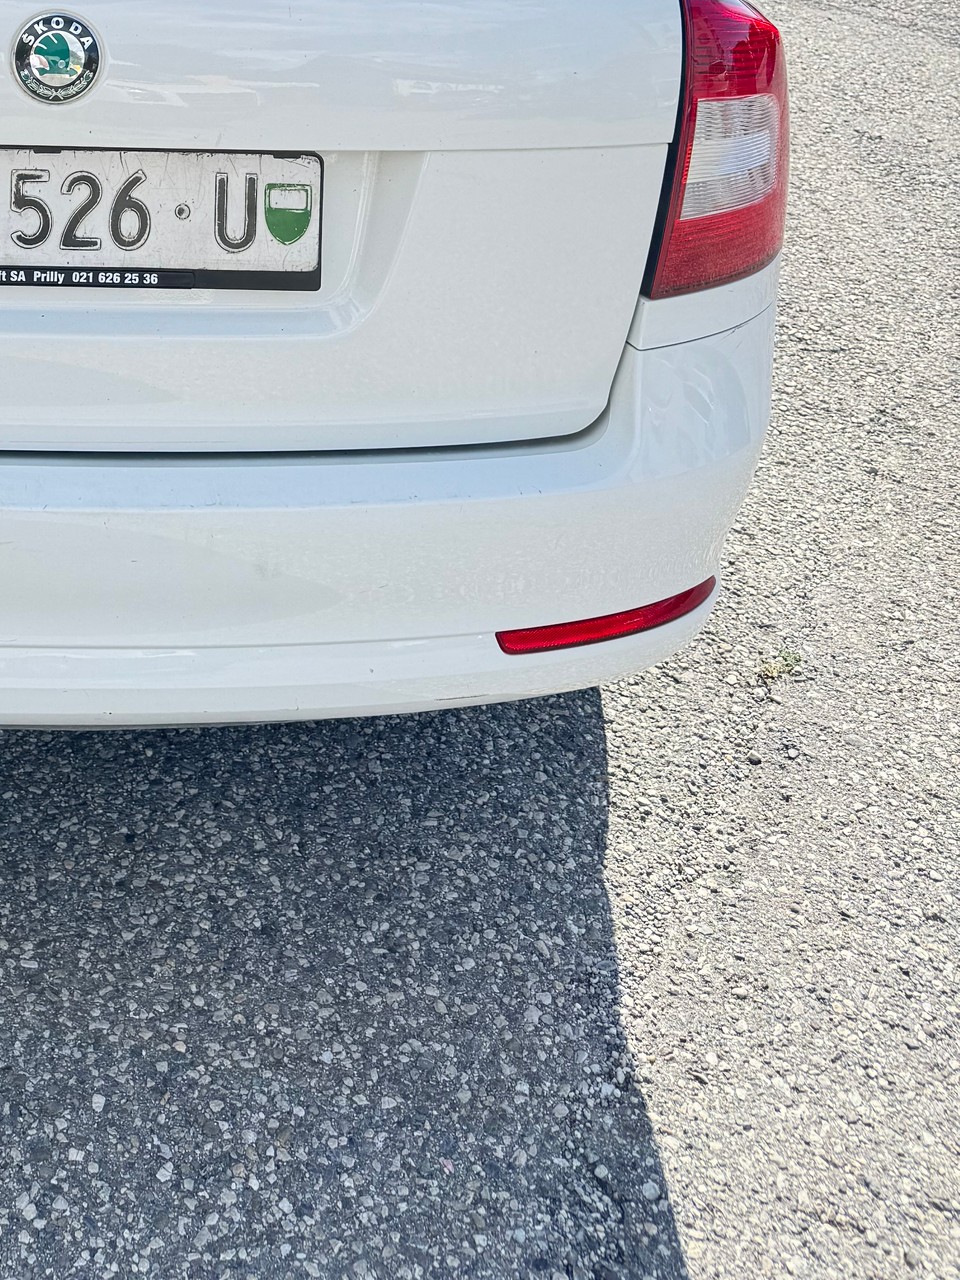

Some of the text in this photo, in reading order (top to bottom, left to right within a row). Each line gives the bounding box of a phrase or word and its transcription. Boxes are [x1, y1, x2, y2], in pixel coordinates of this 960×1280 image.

[9, 270, 27, 282] SA
[32, 270, 65, 285] Prilly
[71, 271, 94, 283] 021
[97, 272, 121, 284] 626
[123, 272, 140, 285] 25
[142, 273, 159, 285] 36
